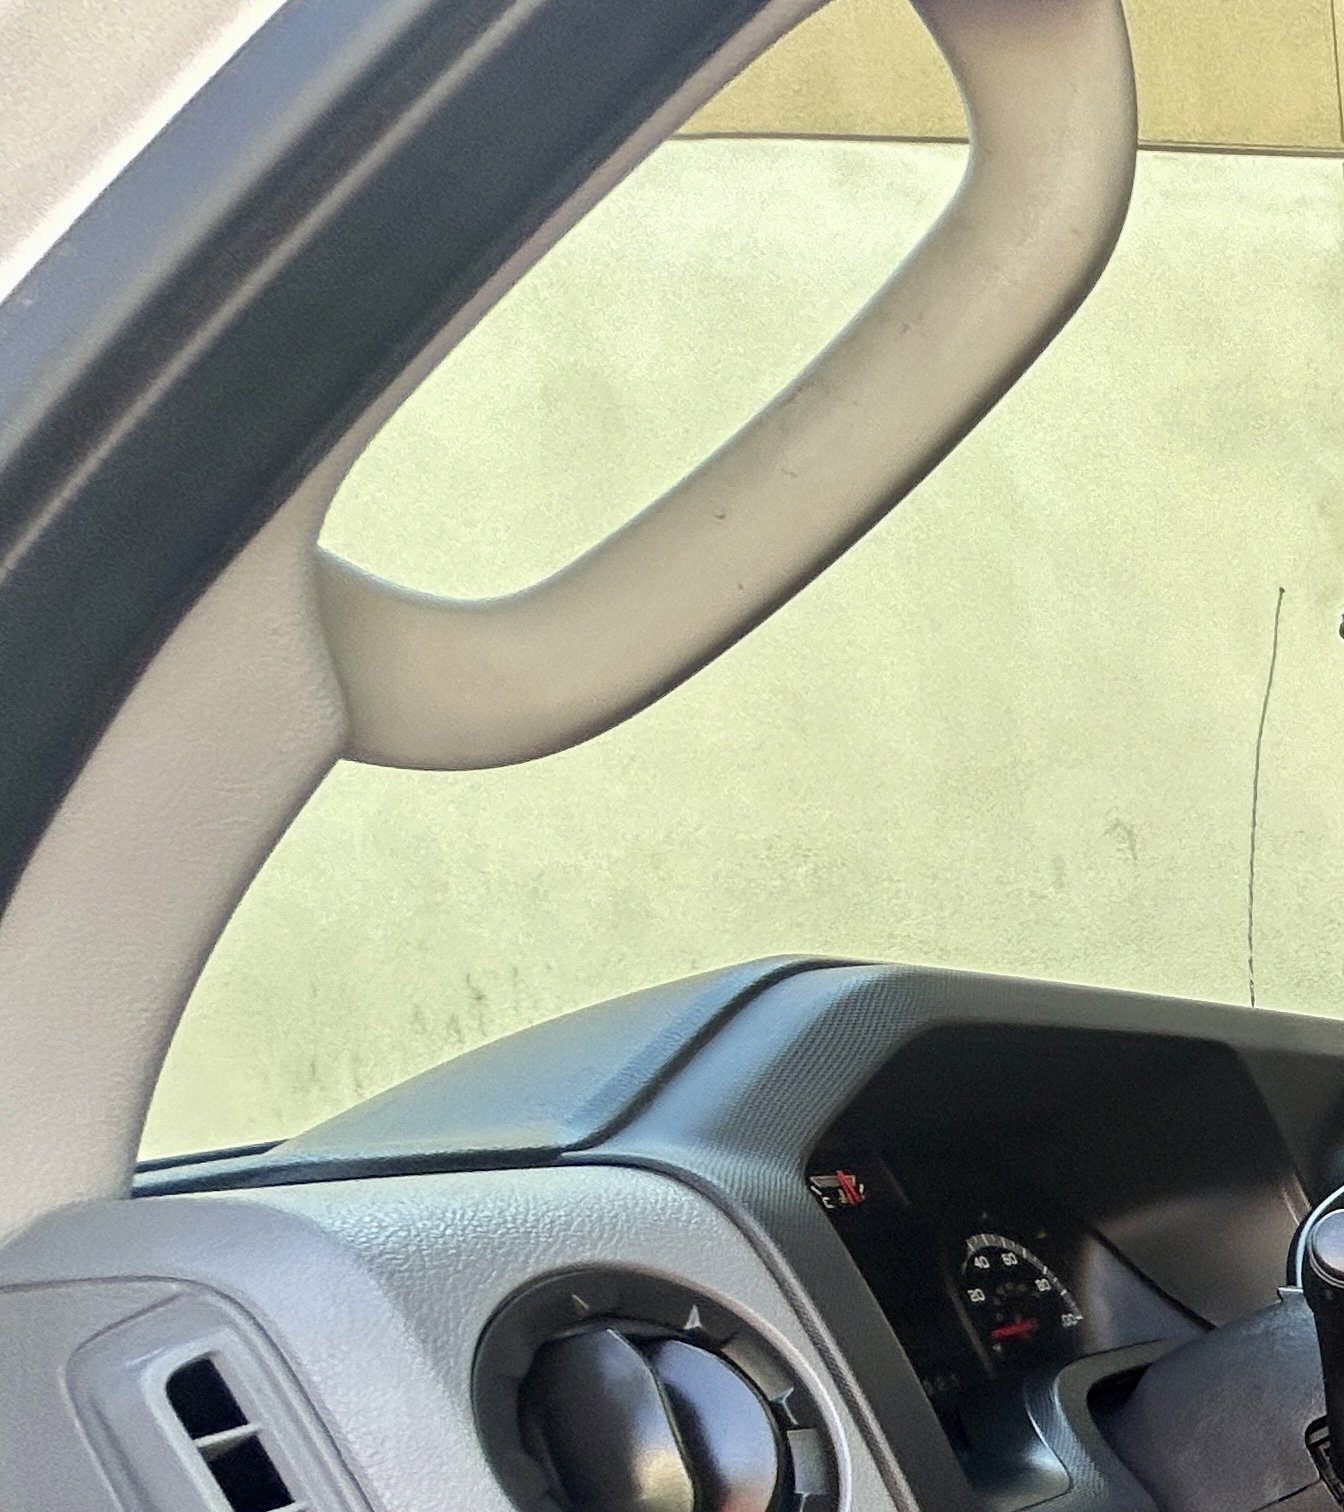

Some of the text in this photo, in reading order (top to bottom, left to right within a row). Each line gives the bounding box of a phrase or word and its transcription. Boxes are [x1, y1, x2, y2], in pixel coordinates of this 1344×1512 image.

[974, 1255, 990, 1269] 40
[1001, 1252, 1018, 1266] 60
[967, 1288, 986, 1302] 20
